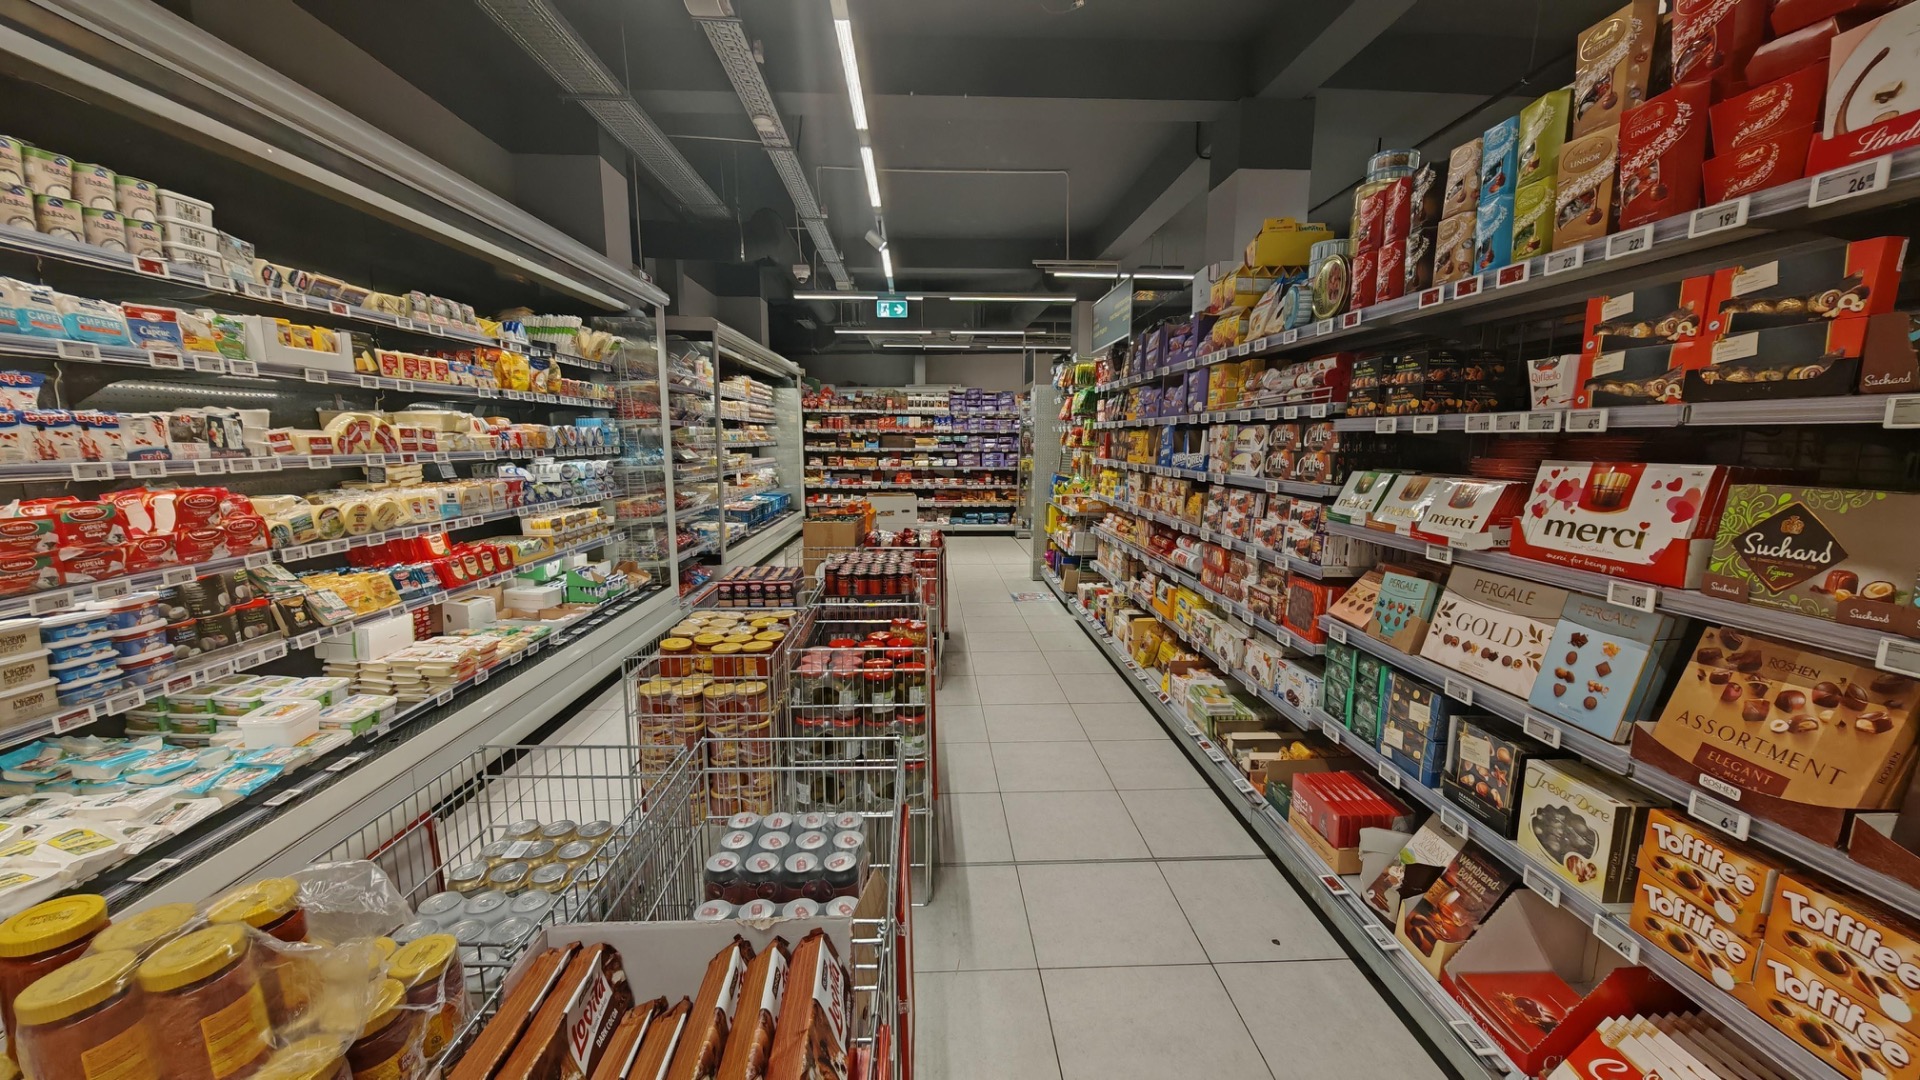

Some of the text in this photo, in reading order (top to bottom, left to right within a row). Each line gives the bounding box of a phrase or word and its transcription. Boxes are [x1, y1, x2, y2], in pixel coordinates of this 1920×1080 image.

[1630, 120, 1661, 138] LINDOR
[1570, 152, 1600, 168] LINDOR
[1848, 176, 1866, 194] 26
[27, 310, 58, 324] СИРЕ
[76, 316, 121, 330] СИРЕНЕ
[1532, 370, 1562, 384] Raffaello
[1864, 371, 1912, 388] Suchard
[1270, 425, 1295, 446] Coffee
[1304, 424, 1332, 447] Coffee
[1172, 452, 1187, 465] OREO
[1187, 454, 1204, 467] OREO
[1265, 451, 1290, 472] Coffee
[1297, 452, 1325, 476] Coffee
[1339, 498, 1372, 511] merci
[1384, 505, 1419, 518] merci
[1, 524, 35, 532] LACRIMA
[1428, 513, 1479, 530] merci
[1543, 518, 1651, 549] merci
[1744, 532, 1833, 564] Suchard
[2, 560, 34, 569] LACRIMA
[1570, 555, 1584, 566] for
[1585, 559, 1607, 573] being
[1389, 577, 1419, 593] PERGALE
[1474, 578, 1536, 605] PERGALE
[1711, 582, 1739, 595] Suchard
[1631, 596, 1641, 607] 18
[1578, 602, 1640, 629] PERGALE
[1850, 608, 1890, 624] Suchard
[1455, 612, 1525, 648] GOLD
[1769, 657, 1821, 679] ROSHEN
[1676, 710, 1847, 786] ASSORTMENT
[1707, 751, 1774, 786] ELEGANT
[1723, 770, 1747, 785] MILK
[1878, 752, 1901, 785] ROSHEN
[1526, 767, 1610, 823] Tresor Dore
[1703, 777, 1738, 797] ROSHEN
[1720, 817, 1728, 829] 6
[1652, 823, 1756, 897] Toffifee
[1457, 868, 1486, 894] Bohnen
[1460, 854, 1500, 890] Weinbrand-
[1642, 883, 1747, 963] Toffifee
[1781, 889, 1920, 989] Toffifee
[1766, 960, 1911, 1068] Toffifee
[595, 1008, 619, 1049] DARK COCOA
